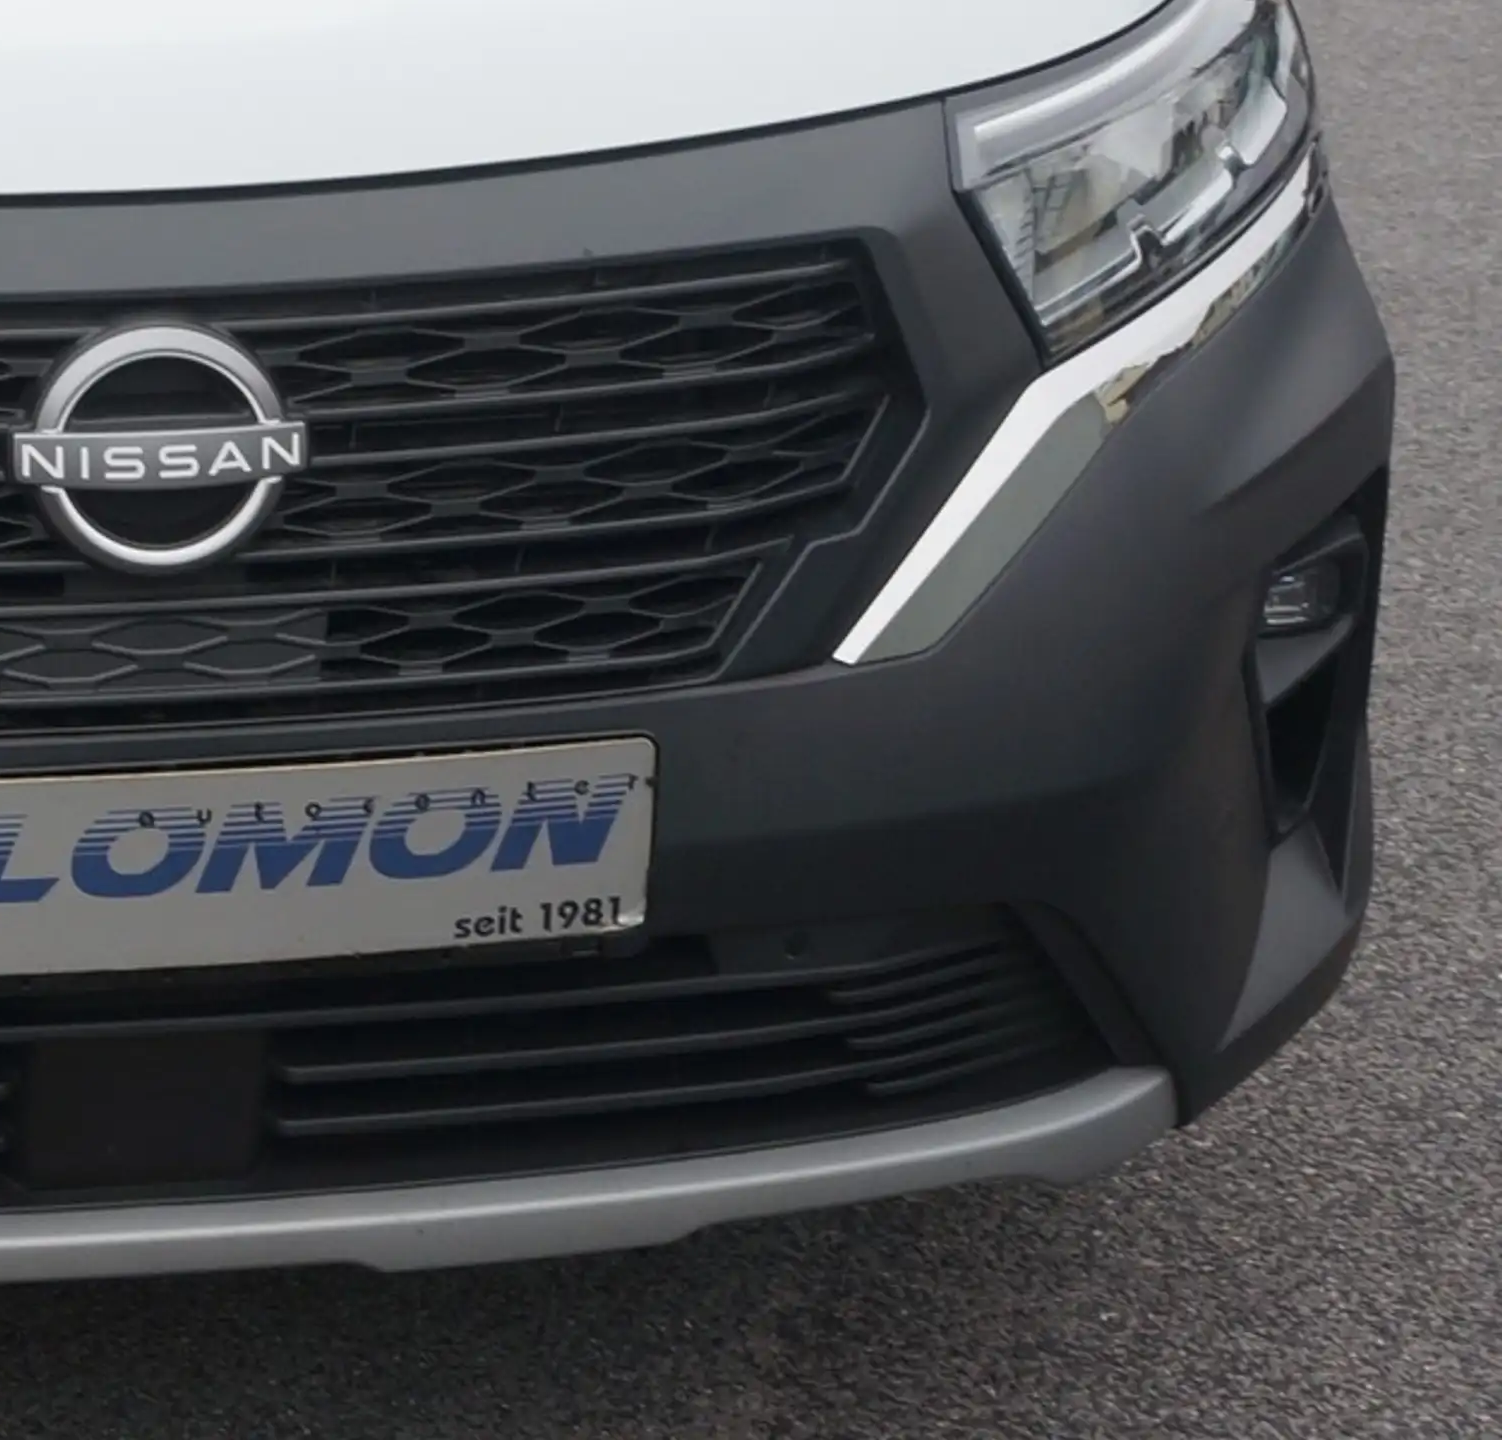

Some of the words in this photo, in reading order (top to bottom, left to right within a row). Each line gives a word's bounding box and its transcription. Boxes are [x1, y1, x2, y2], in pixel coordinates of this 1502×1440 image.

[21, 432, 301, 480] NISSAN
[454, 905, 524, 939] seit
[539, 896, 622, 933] 1981
